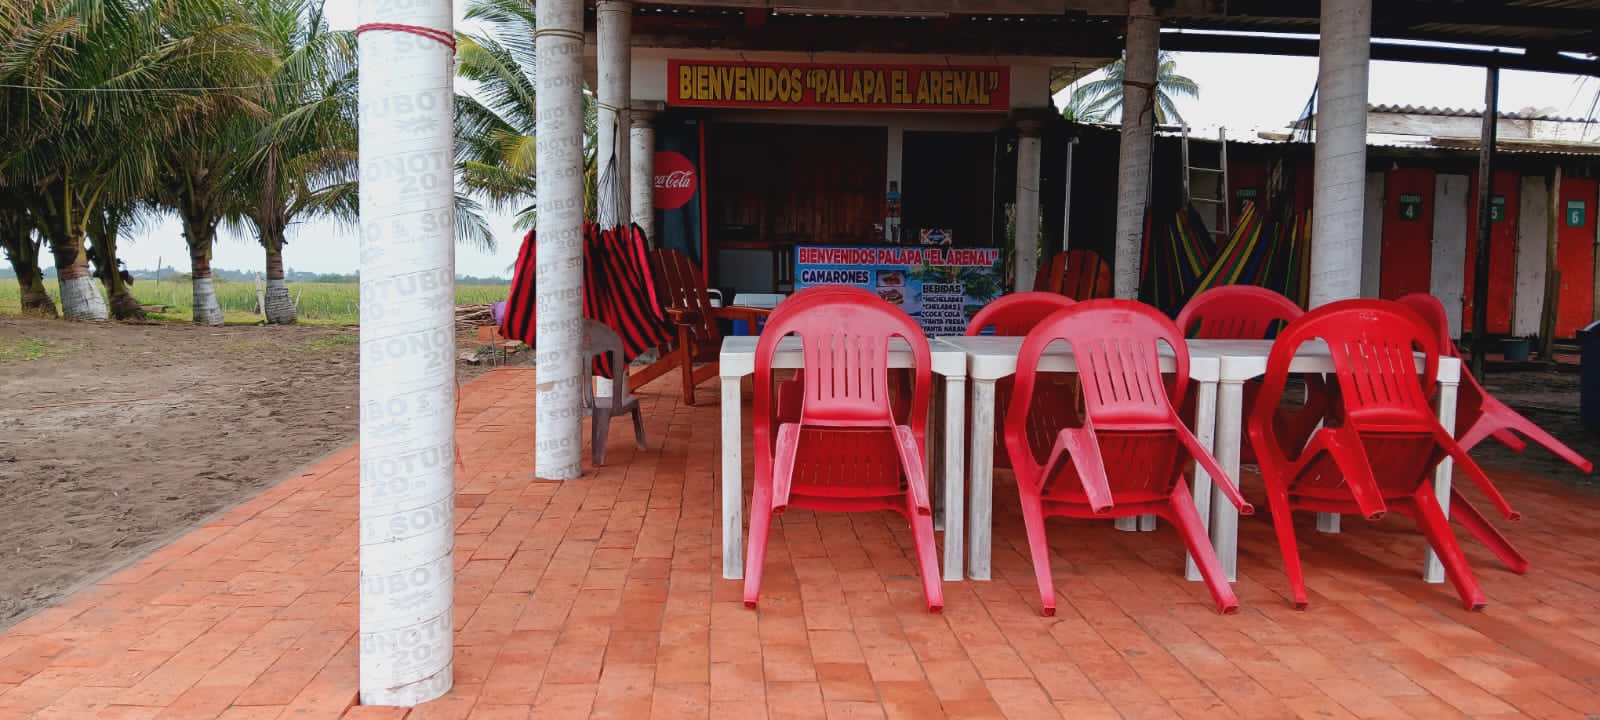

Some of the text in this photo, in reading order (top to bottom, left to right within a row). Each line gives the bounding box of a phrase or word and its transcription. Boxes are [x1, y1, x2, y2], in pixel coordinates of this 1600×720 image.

[679, 65, 802, 103] BIENVENIDOS
[891, 70, 913, 104] EL
[1405, 204, 1414, 219] 4
[1491, 206, 1498, 220] 5
[1572, 211, 1580, 224] 6
[799, 247, 875, 266] BIENVENIDOS
[877, 248, 923, 266] PALAPA
[802, 269, 869, 284] CAMARONES
[922, 284, 961, 295] BEBIDAS
